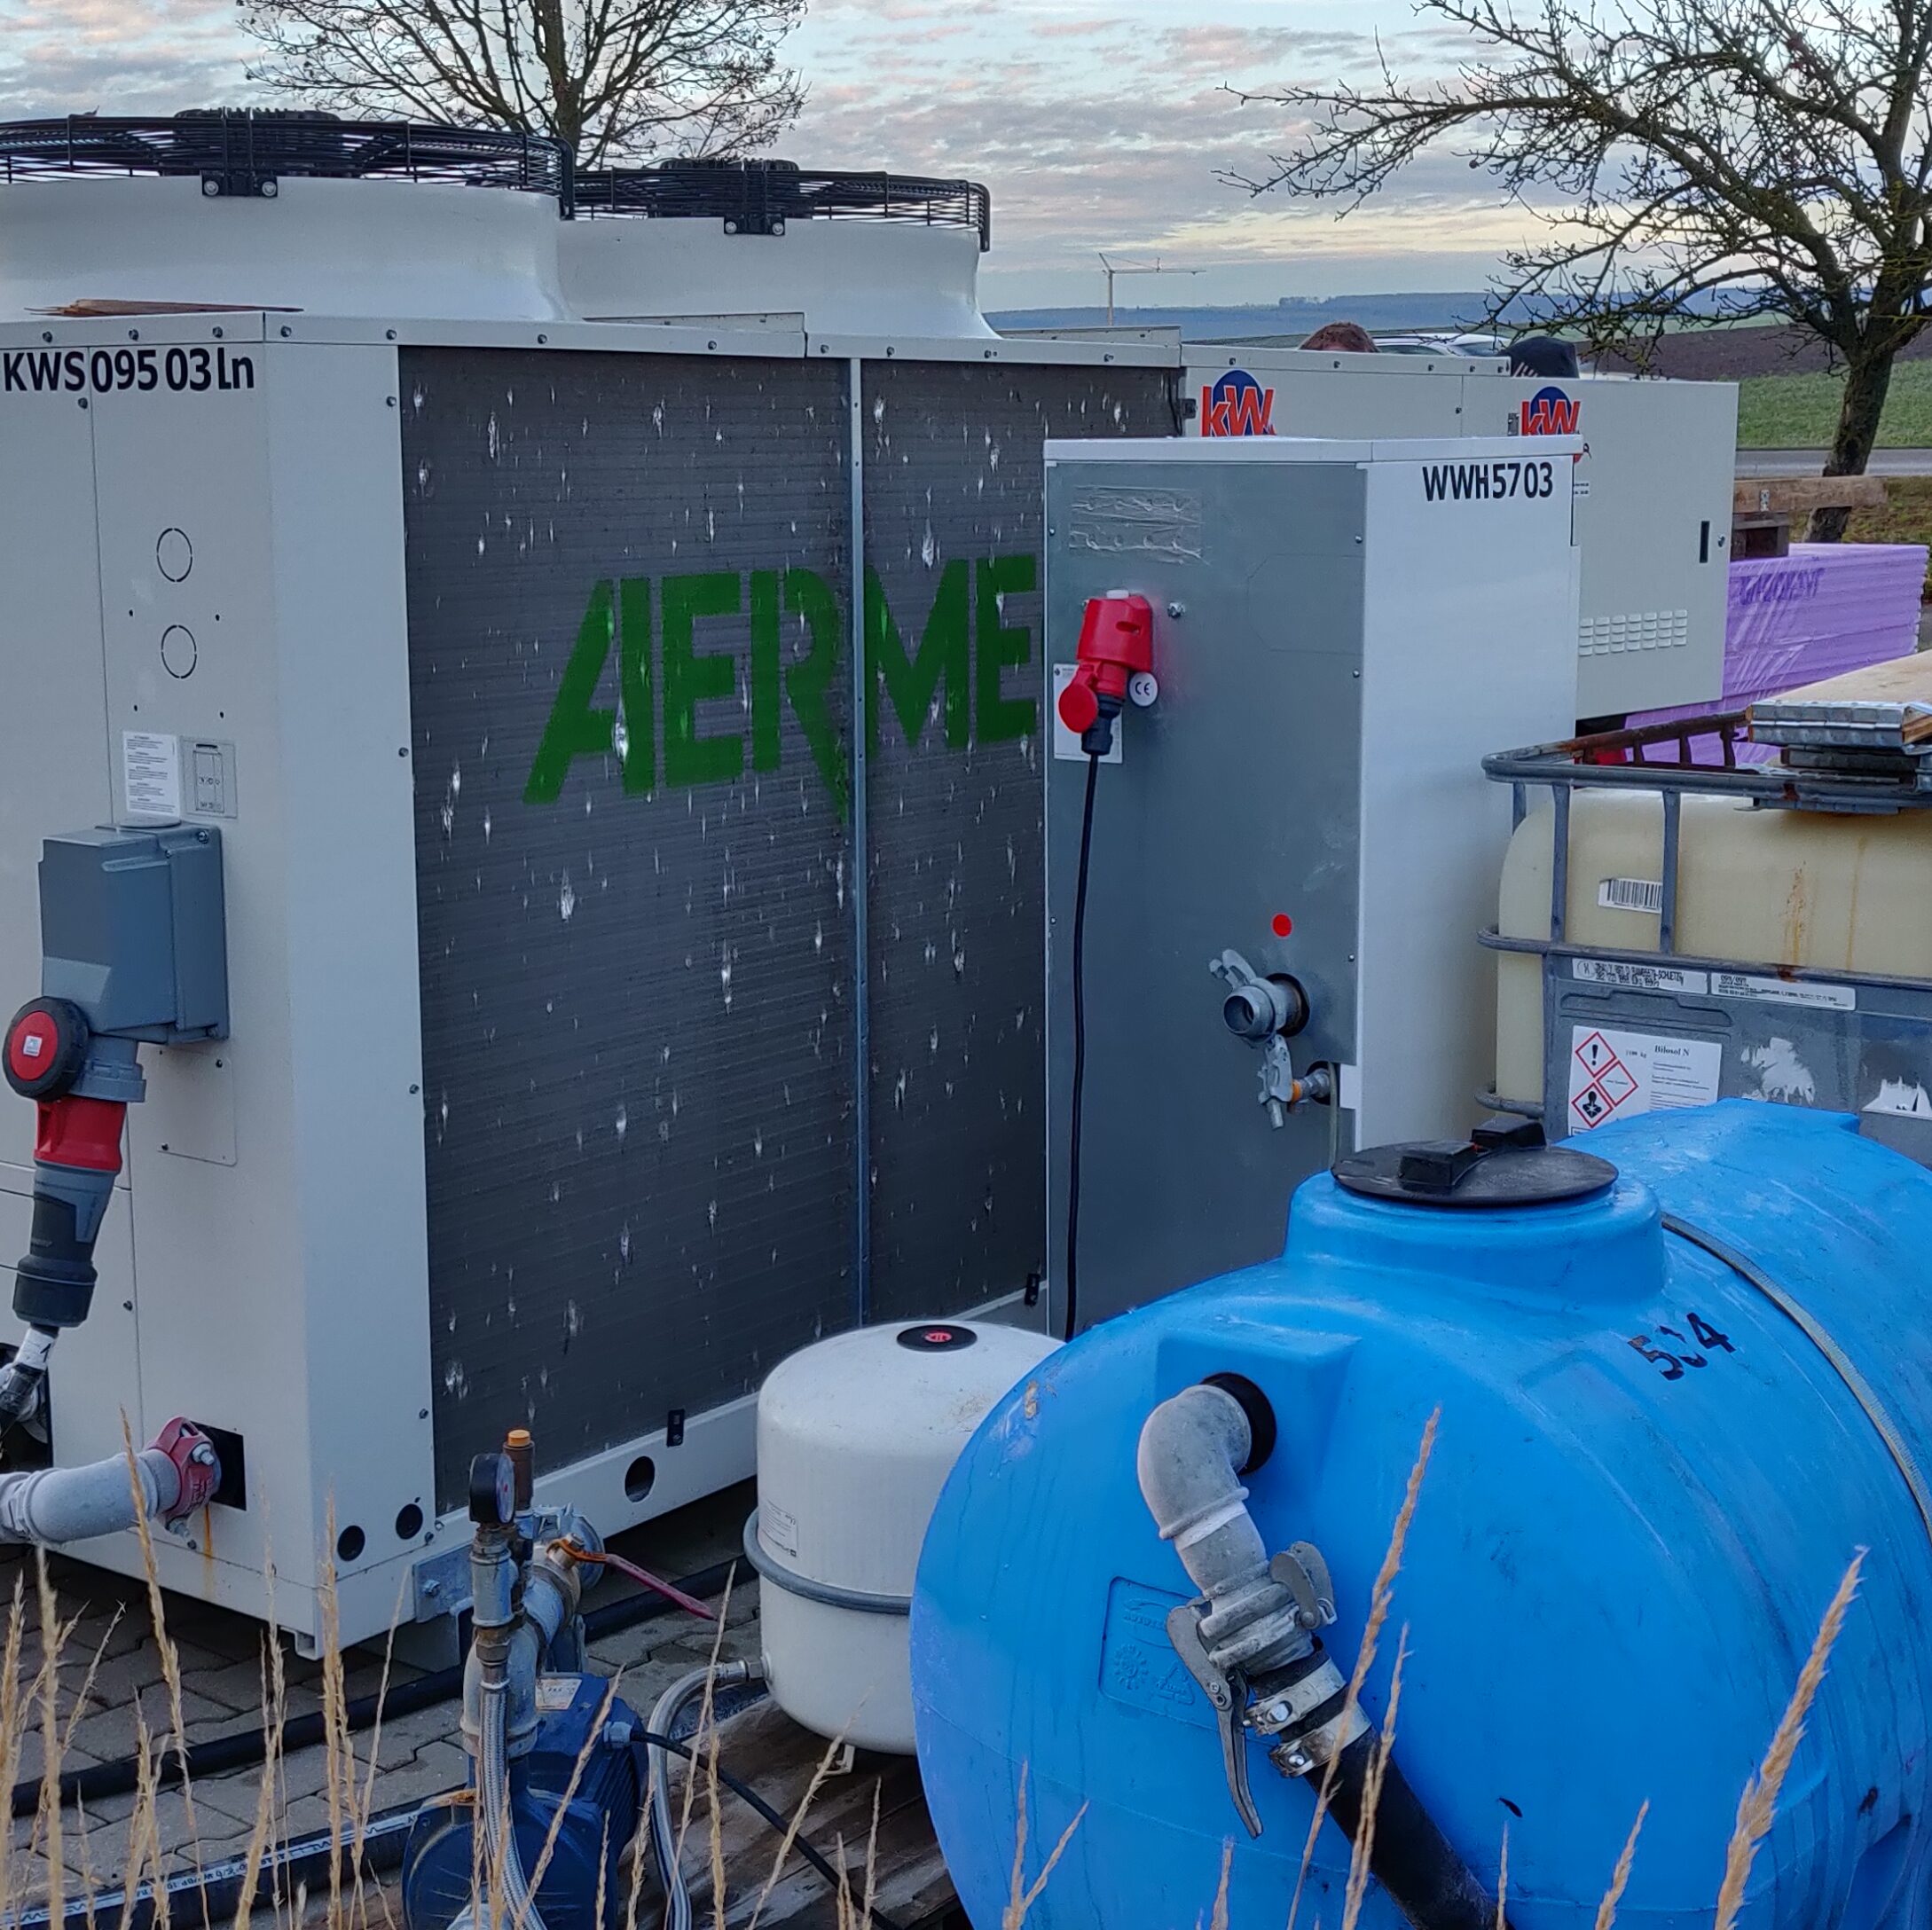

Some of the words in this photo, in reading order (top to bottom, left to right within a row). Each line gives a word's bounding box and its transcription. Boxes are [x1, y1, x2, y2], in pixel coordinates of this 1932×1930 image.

[1422, 461, 1554, 502] WWH5703
[522, 554, 1043, 827] AERME
[1135, 681, 1151, 695] CE
